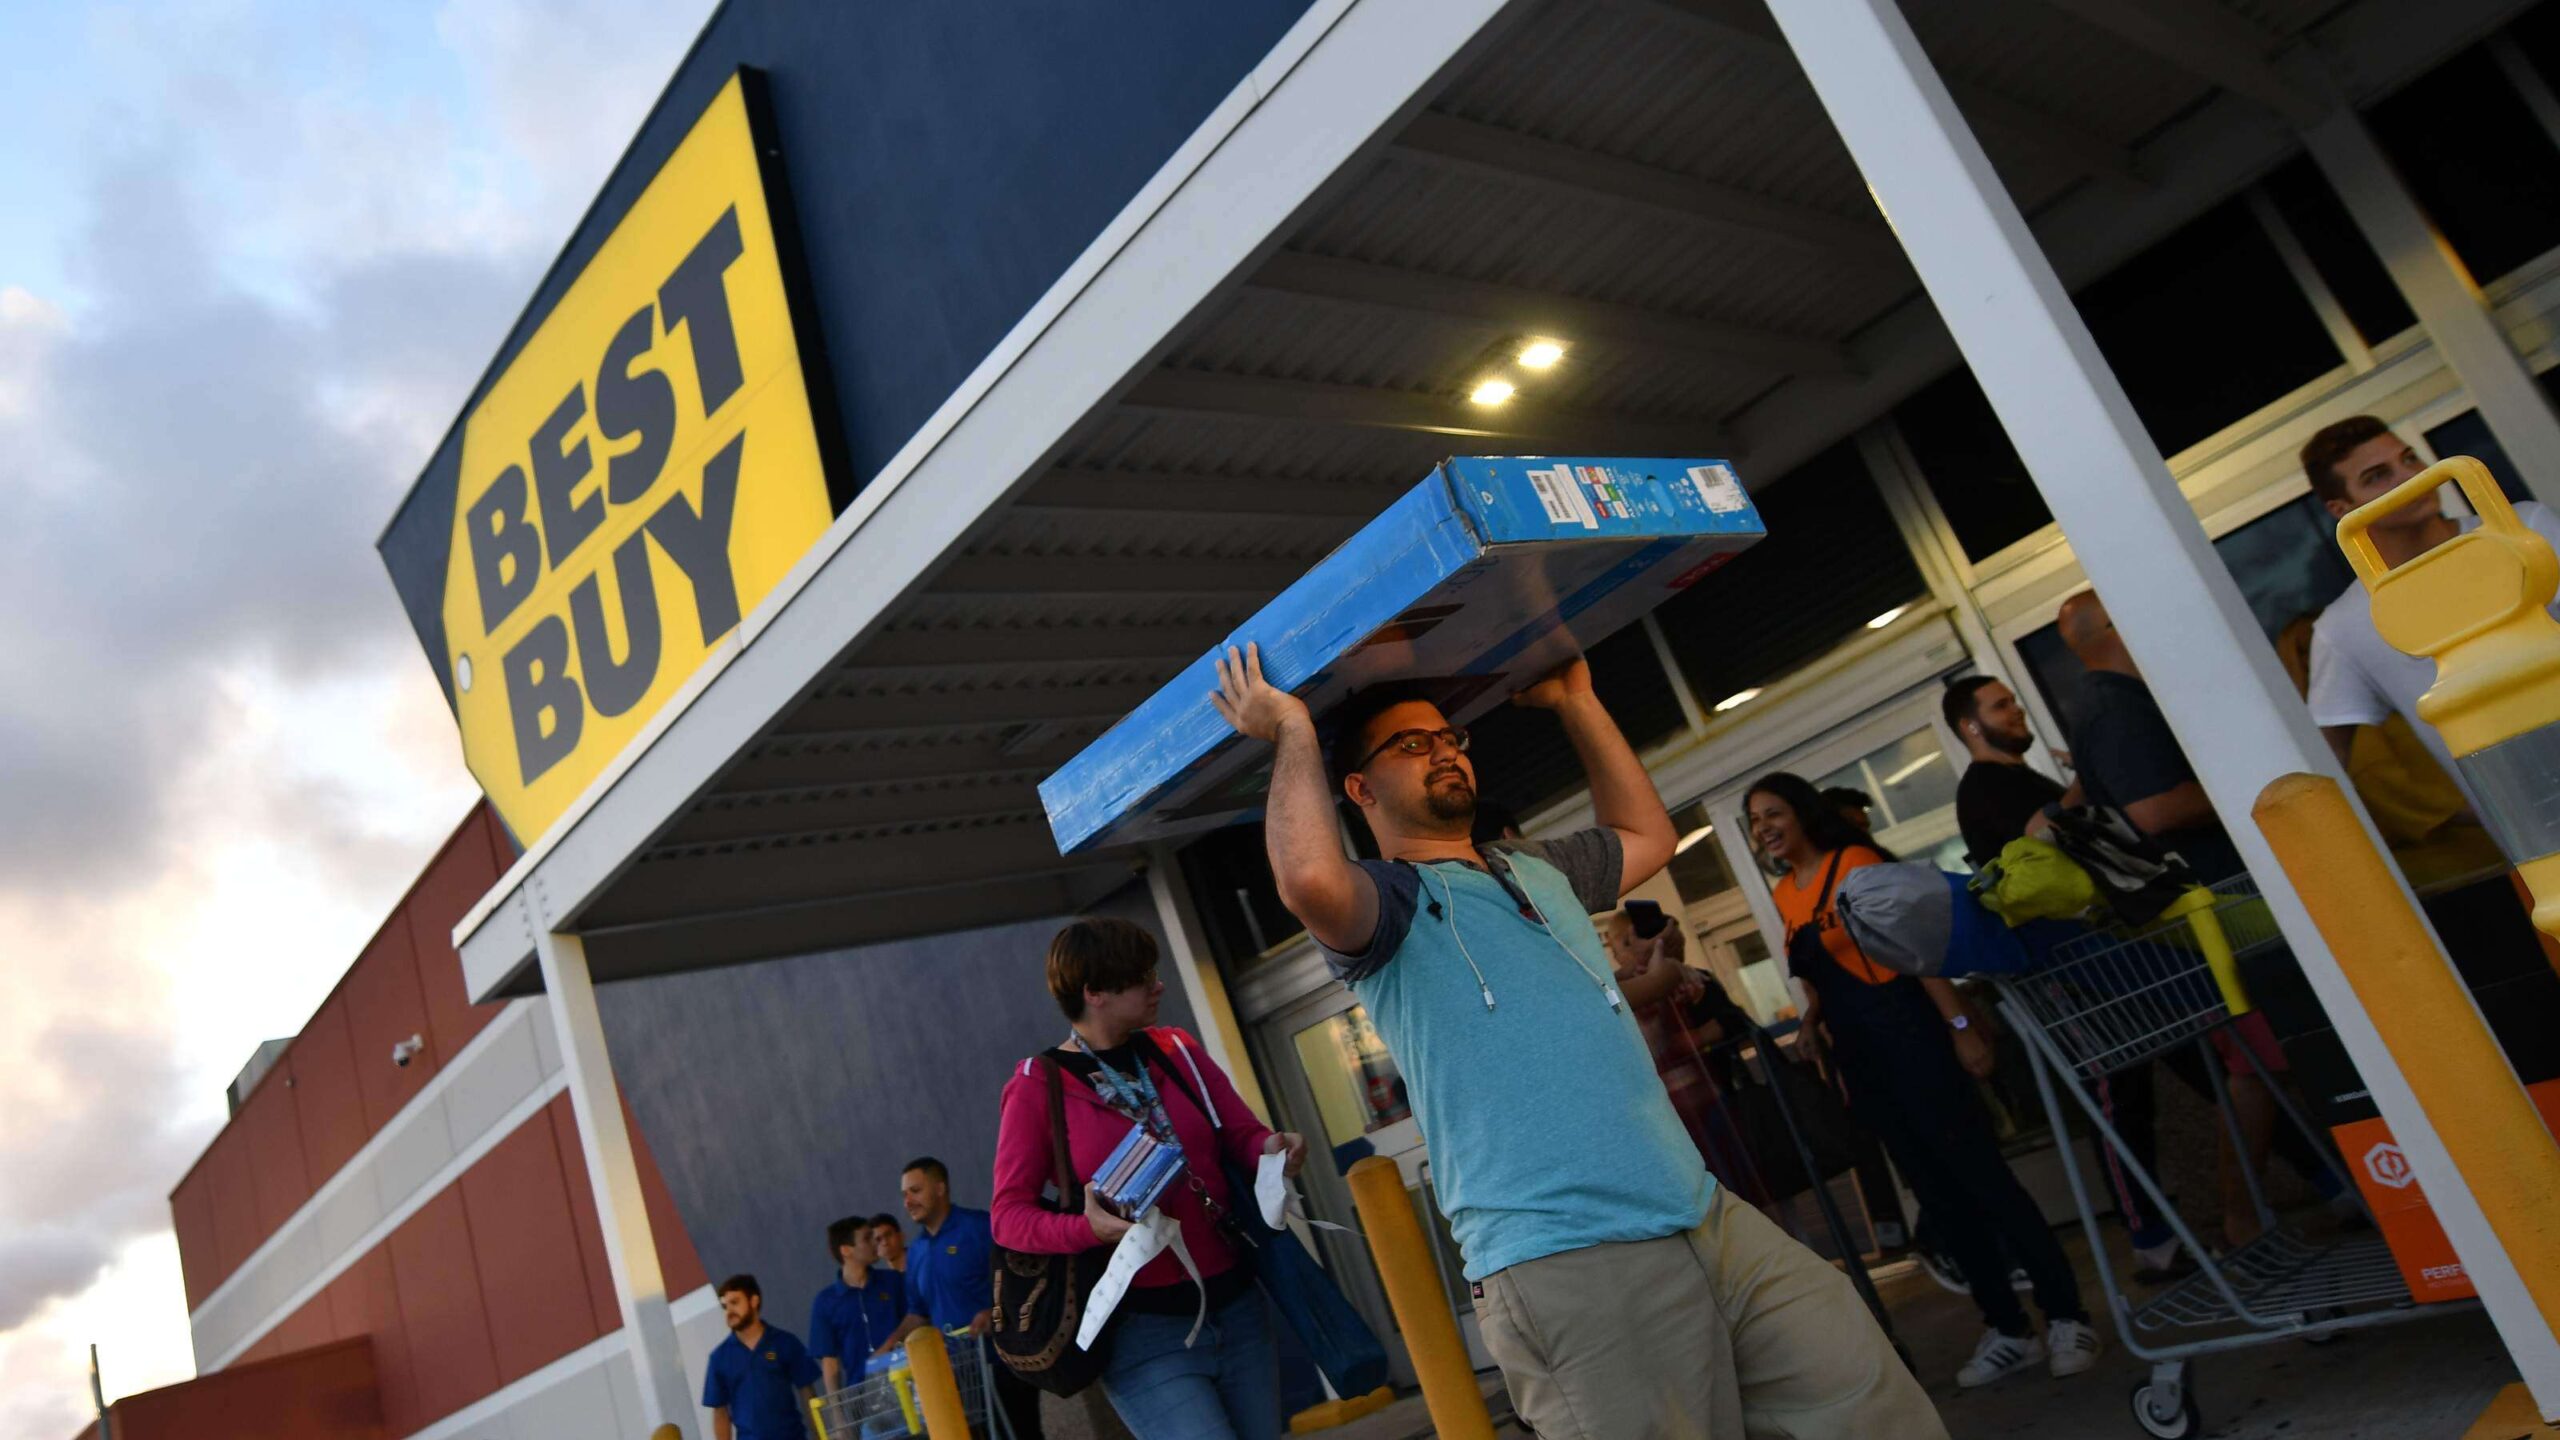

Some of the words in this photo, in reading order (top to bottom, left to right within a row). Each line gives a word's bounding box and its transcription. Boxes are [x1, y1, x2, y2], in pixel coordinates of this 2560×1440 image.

[466, 202, 744, 636] BEST
[502, 427, 746, 788] BUY
[2421, 1264, 2464, 1281] PERF
